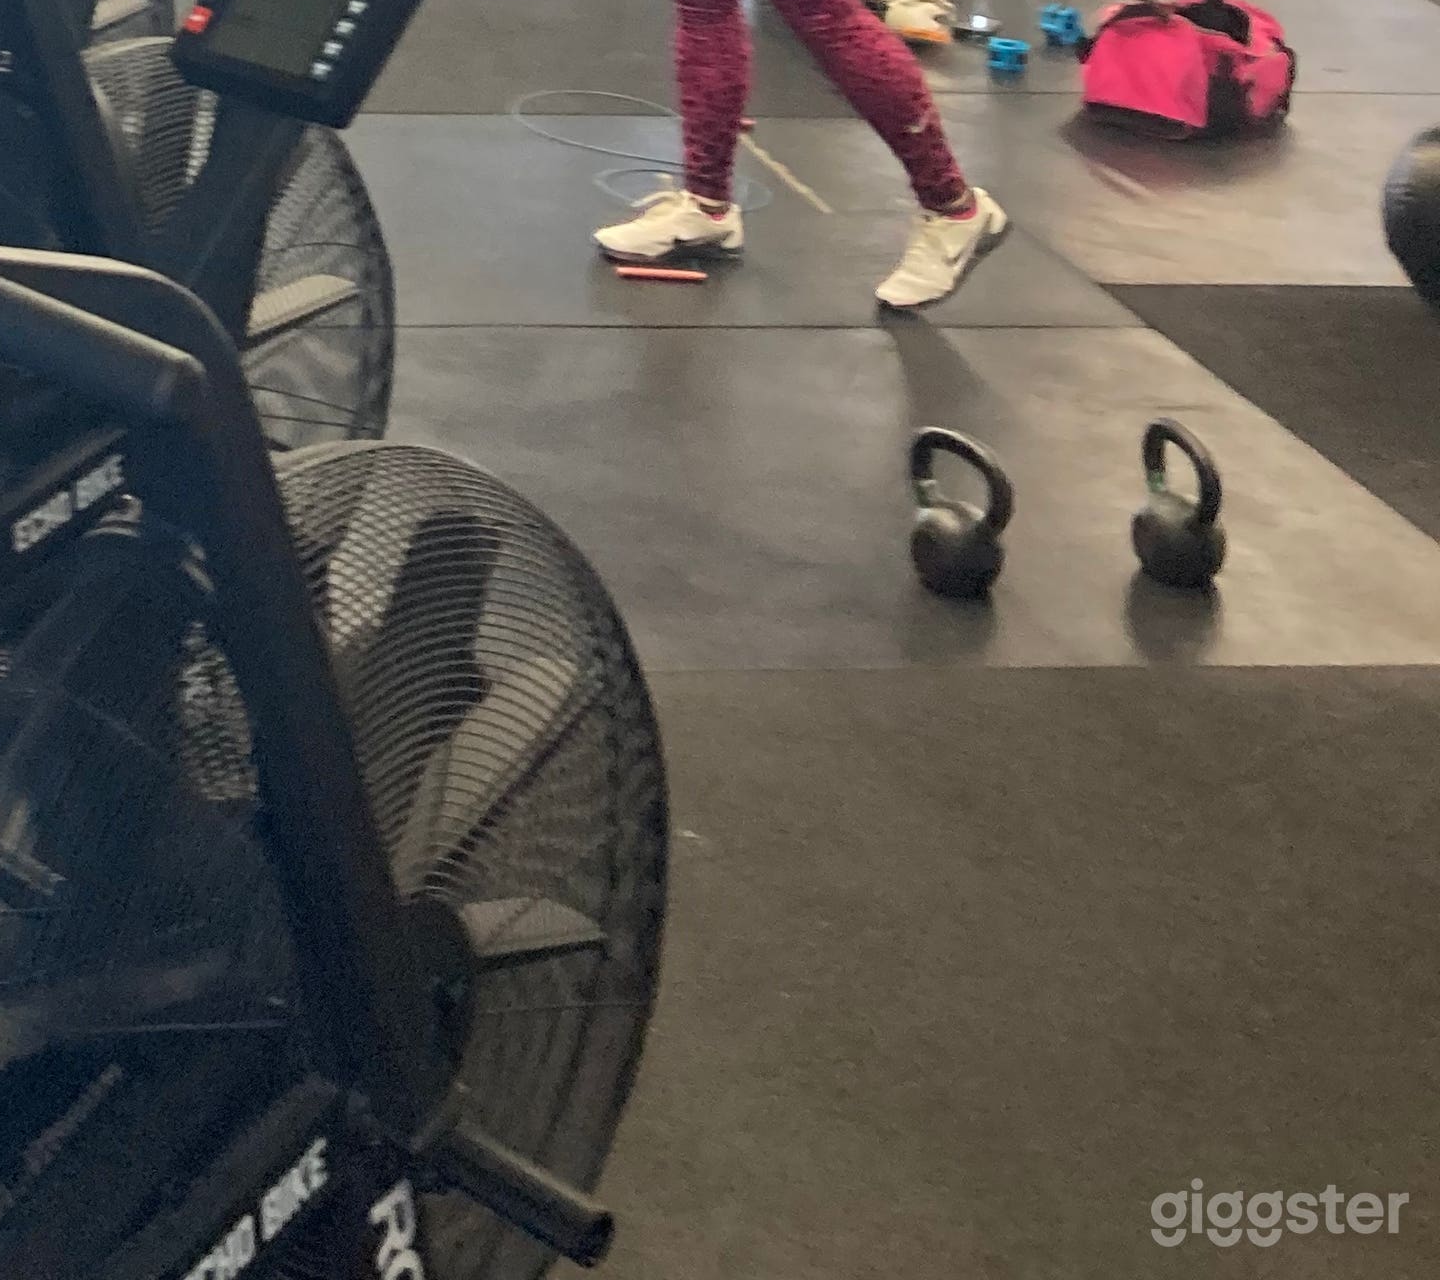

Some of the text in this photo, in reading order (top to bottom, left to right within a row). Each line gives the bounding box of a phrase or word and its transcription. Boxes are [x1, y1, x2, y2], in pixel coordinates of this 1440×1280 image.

[11, 454, 125, 553] ECHO BIKE
[182, 1138, 328, 1280] CHO BIKE
